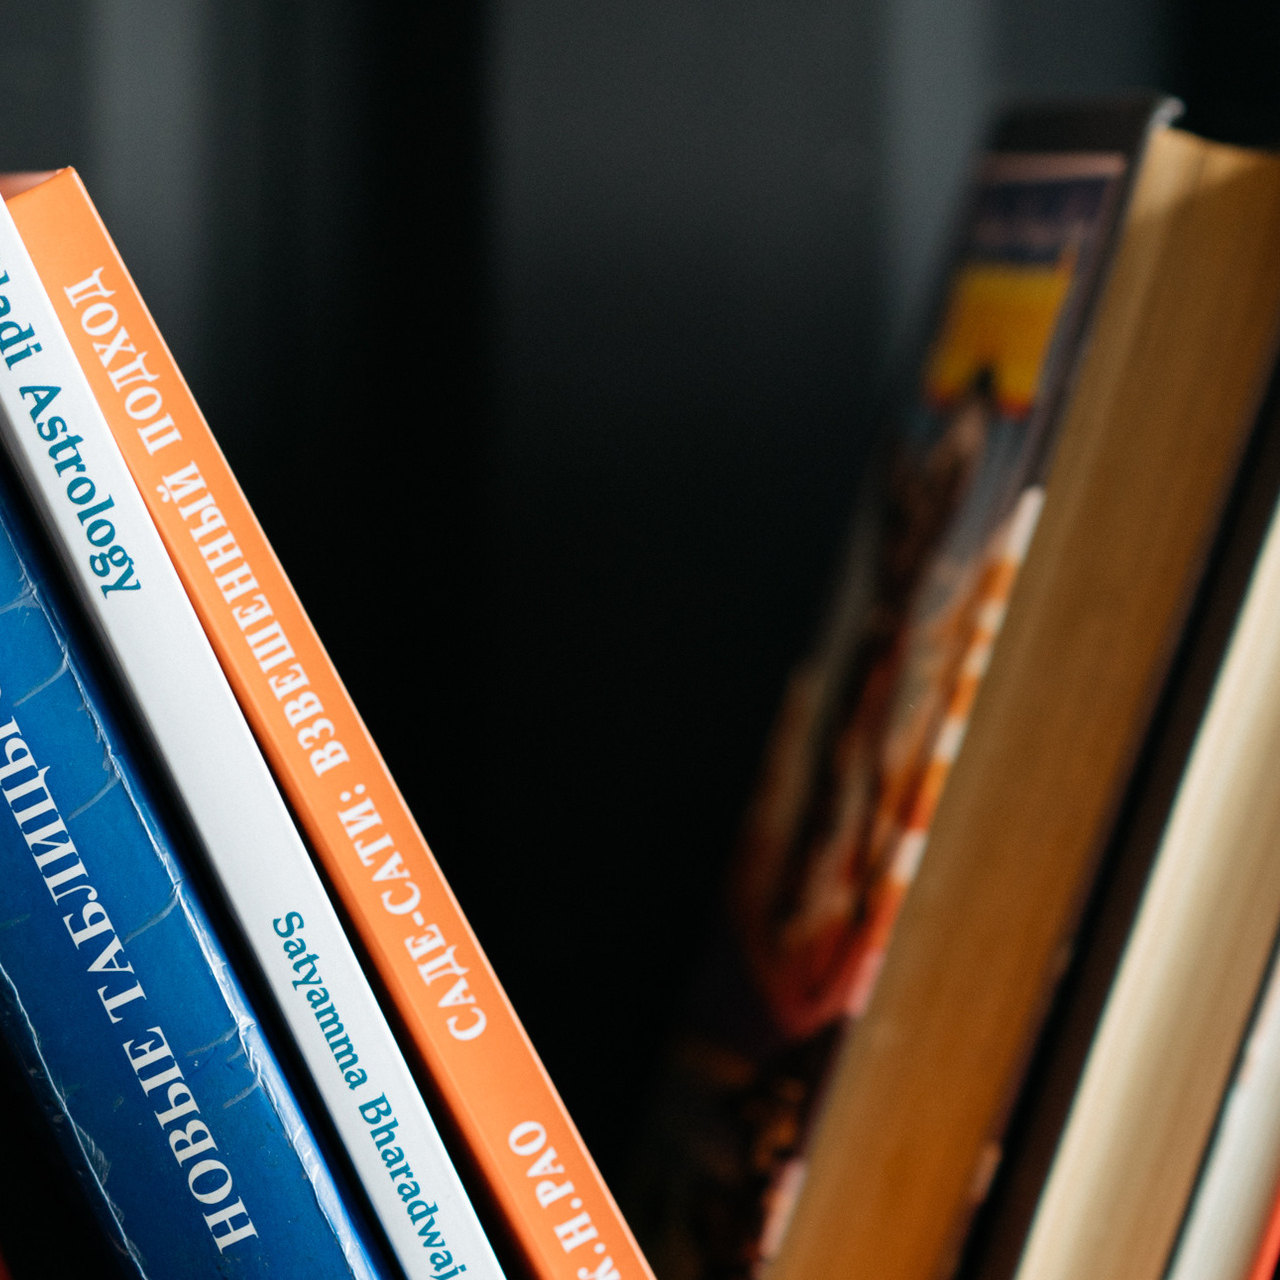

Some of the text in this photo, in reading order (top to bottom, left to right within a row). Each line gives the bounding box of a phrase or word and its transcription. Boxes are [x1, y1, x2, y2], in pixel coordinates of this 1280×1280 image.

[18, 383, 142, 600] Astrology
[62, 266, 488, 1042] САДЕ-САТИ: ВЗВЕШЕННЫЙ ПОДХОД
[272, 910, 369, 1091] Satyamma
[122, 1026, 258, 1252] НОВЫЕ
